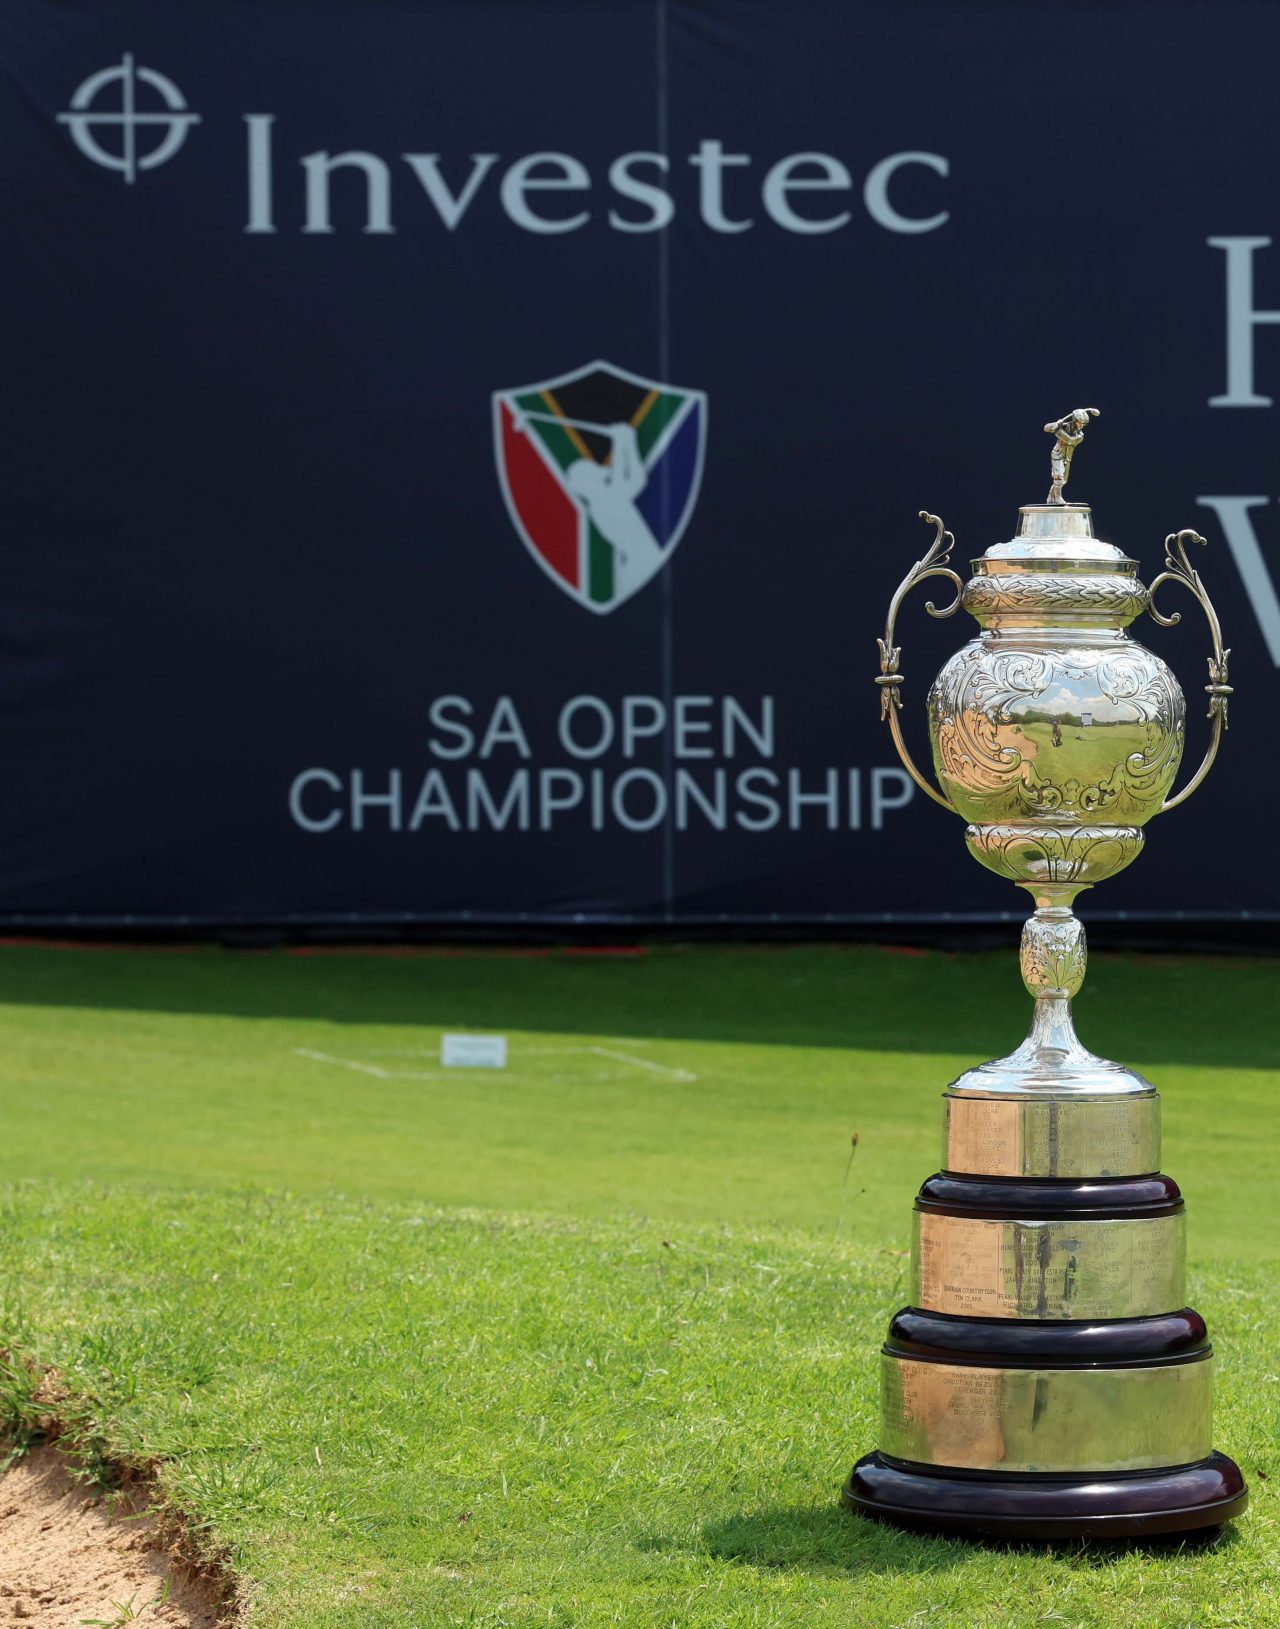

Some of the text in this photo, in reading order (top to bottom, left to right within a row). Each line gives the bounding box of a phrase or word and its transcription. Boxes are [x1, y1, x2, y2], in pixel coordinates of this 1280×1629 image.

[246, 114, 949, 234] Investec
[430, 695, 773, 759] SA OPEN
[289, 768, 914, 831] CHAMPIONSHIP
